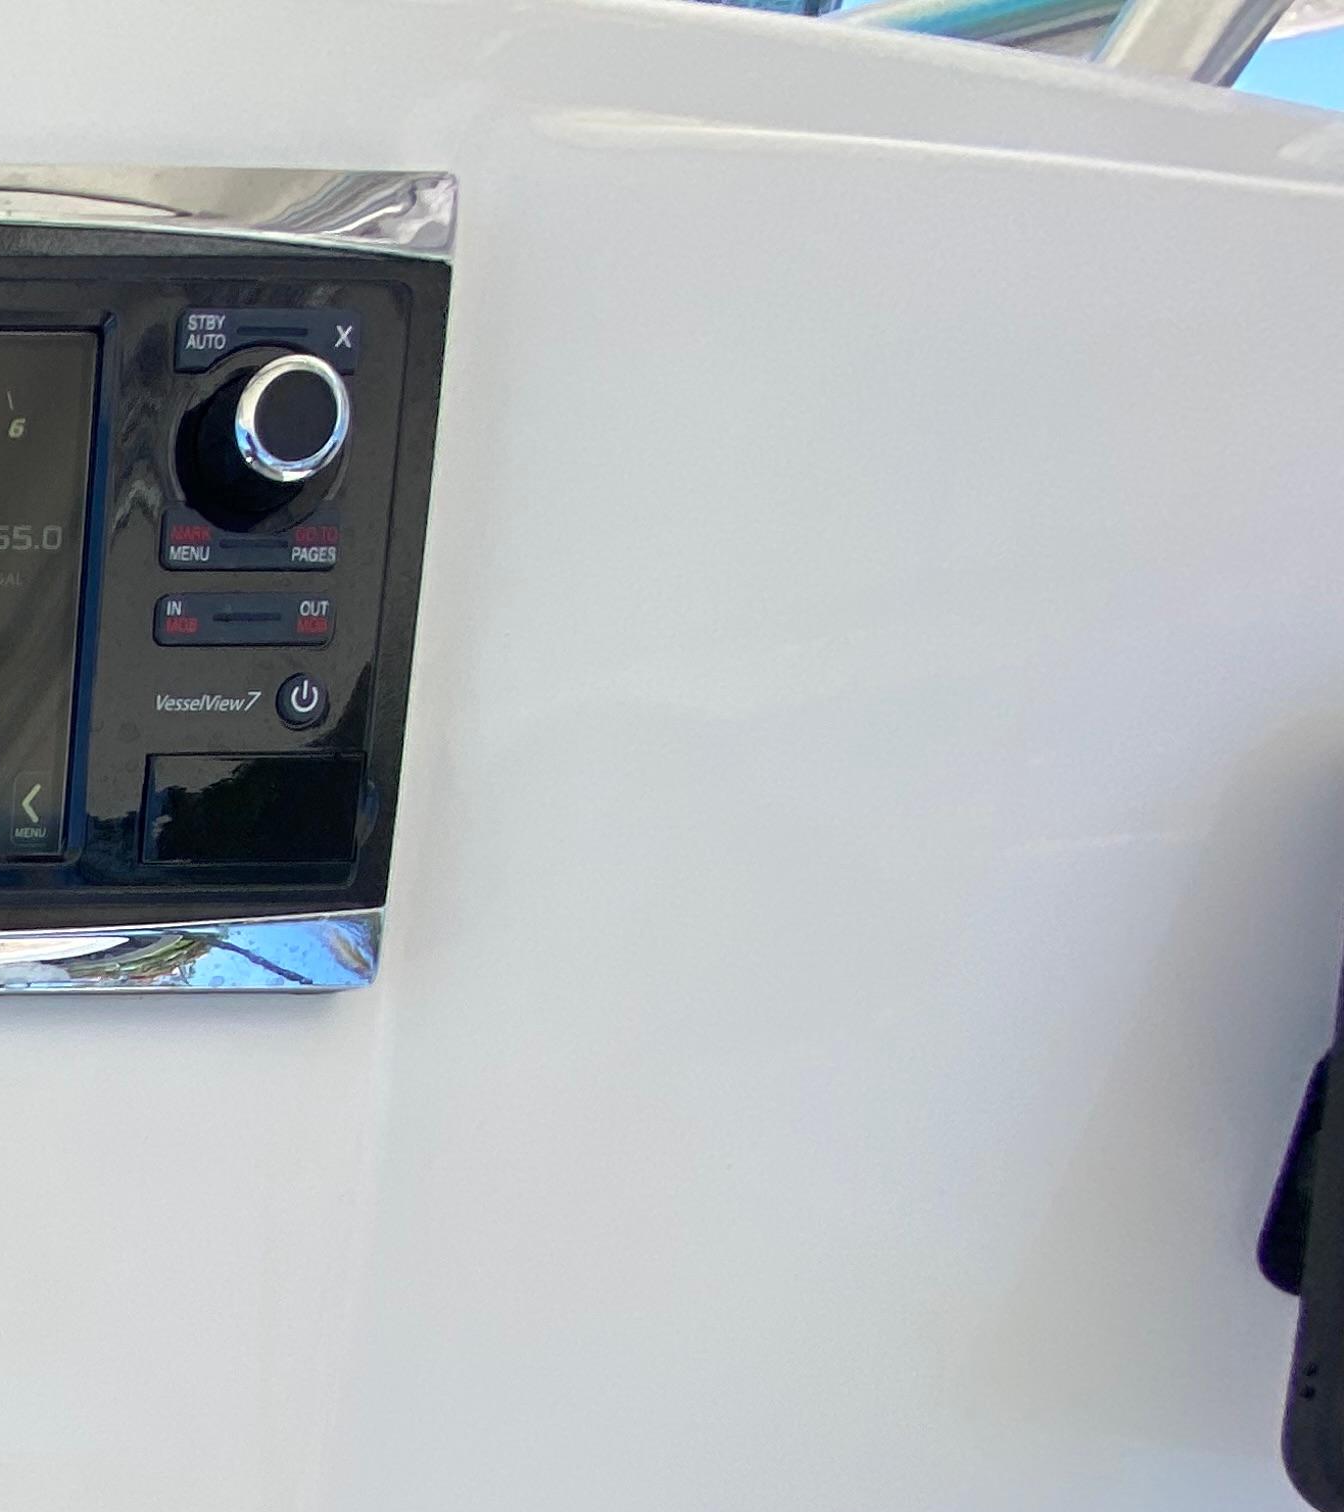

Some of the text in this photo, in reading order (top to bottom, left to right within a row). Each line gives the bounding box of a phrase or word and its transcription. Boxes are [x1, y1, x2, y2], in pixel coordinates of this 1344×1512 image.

[188, 315, 225, 330] STBY
[186, 334, 226, 350] AUTO
[335, 325, 352, 348] X
[170, 546, 210, 561] MENU
[291, 547, 336, 562] PAGES
[167, 601, 182, 616] IN
[300, 601, 329, 616] OUT
[15, 827, 47, 839] MENU
